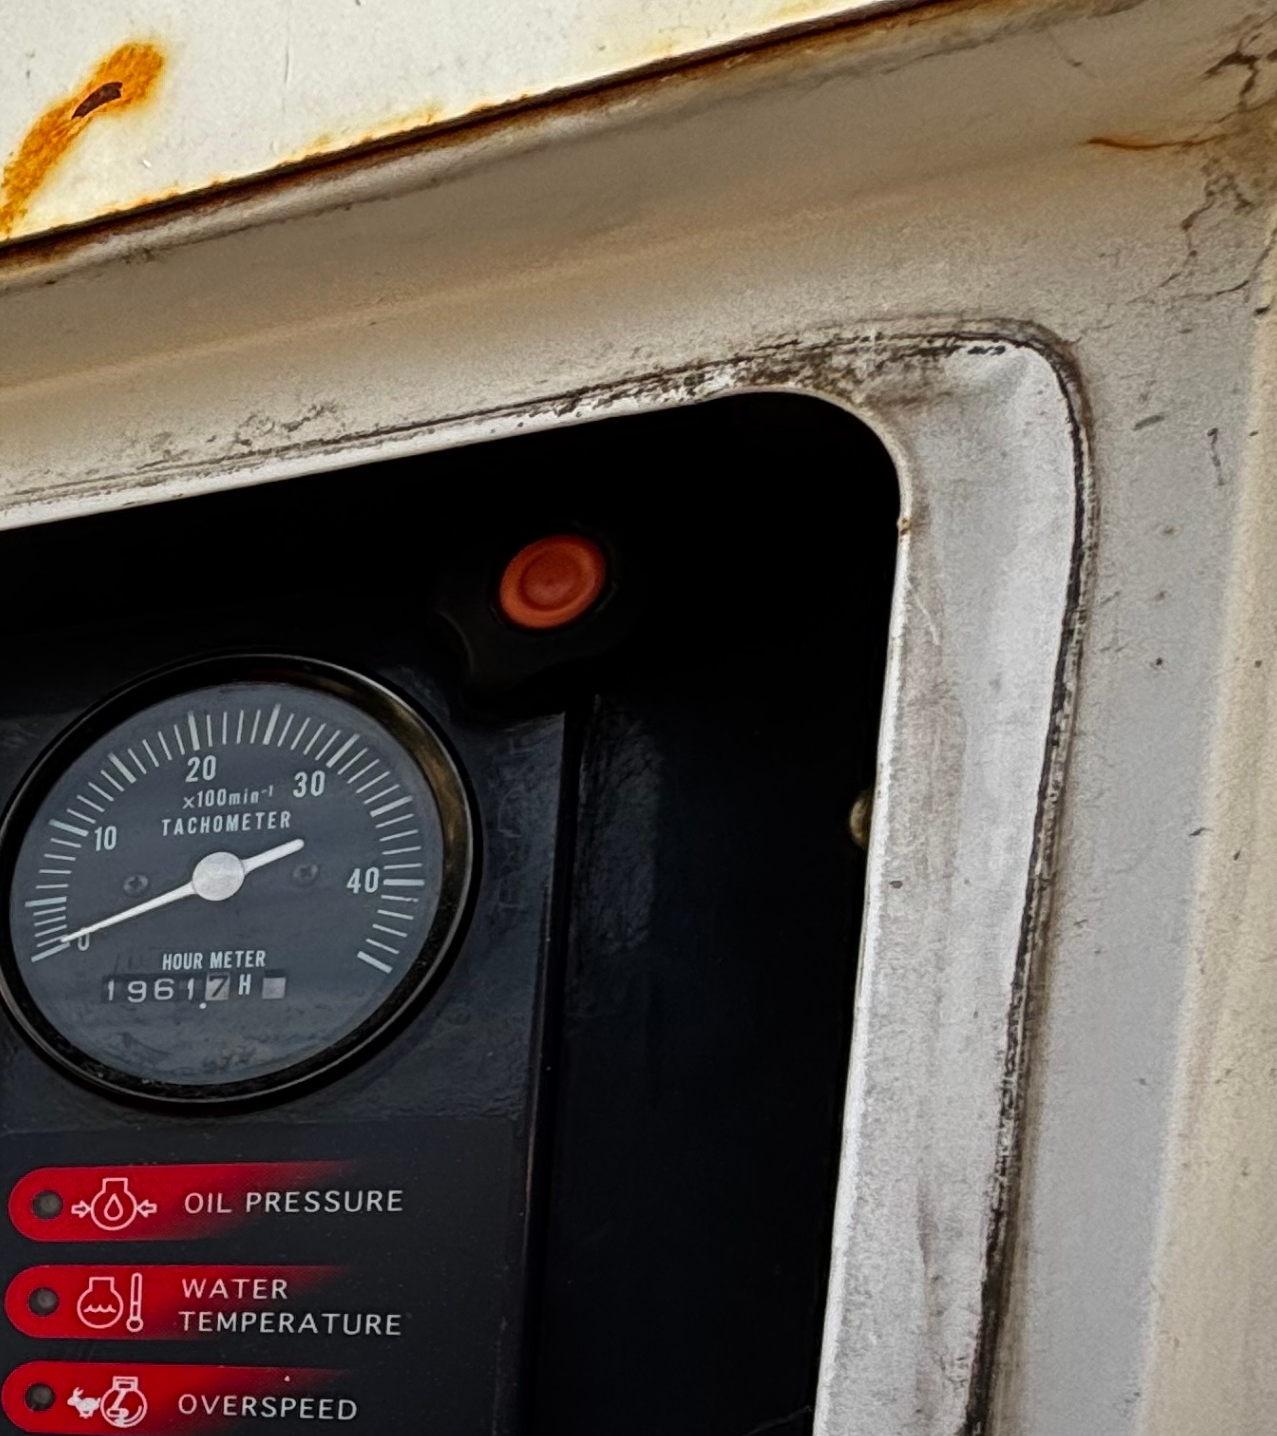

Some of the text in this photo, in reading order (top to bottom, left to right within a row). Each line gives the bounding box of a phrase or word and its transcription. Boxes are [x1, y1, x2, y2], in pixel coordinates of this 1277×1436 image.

[185, 756, 217, 781] 20
[293, 771, 325, 797] 30
[162, 811, 291, 835] TACHOMETER
[94, 827, 117, 851] 10
[347, 868, 379, 893] 40
[162, 951, 266, 970] HOUR METER
[239, 975, 251, 994] H
[184, 1189, 403, 1214] OIL PRESSURE
[182, 1279, 289, 1300] WATER
[179, 1311, 402, 1336] TEMPERATURE
[178, 1394, 358, 1421] OVERSPEED
